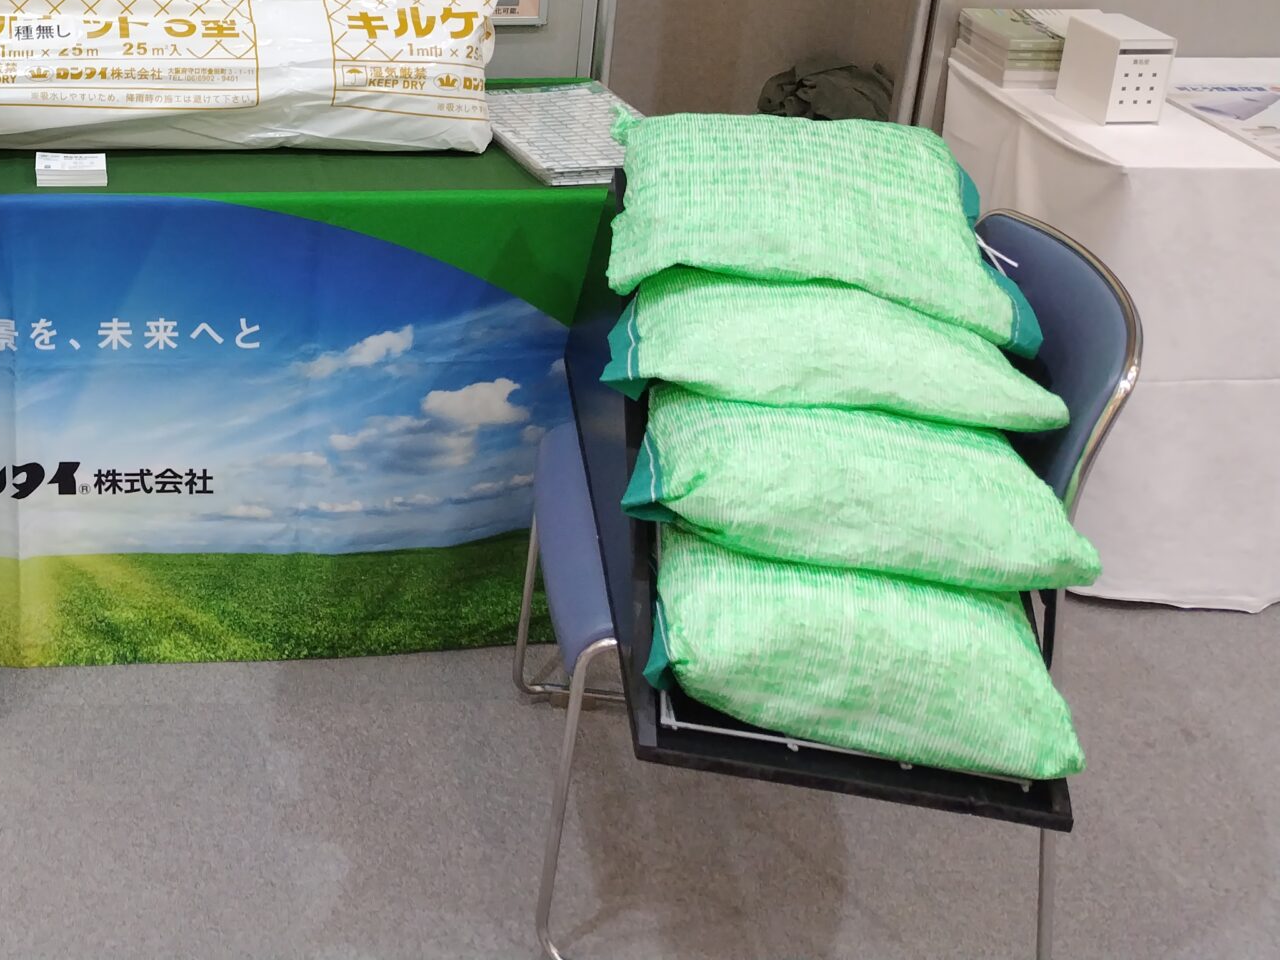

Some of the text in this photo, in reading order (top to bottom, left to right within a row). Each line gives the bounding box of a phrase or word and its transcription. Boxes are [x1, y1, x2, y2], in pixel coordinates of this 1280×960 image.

[347, 6, 492, 39] キルケ
[14, 24, 71, 41] 種無し
[368, 78, 426, 90] KEEP DRY
